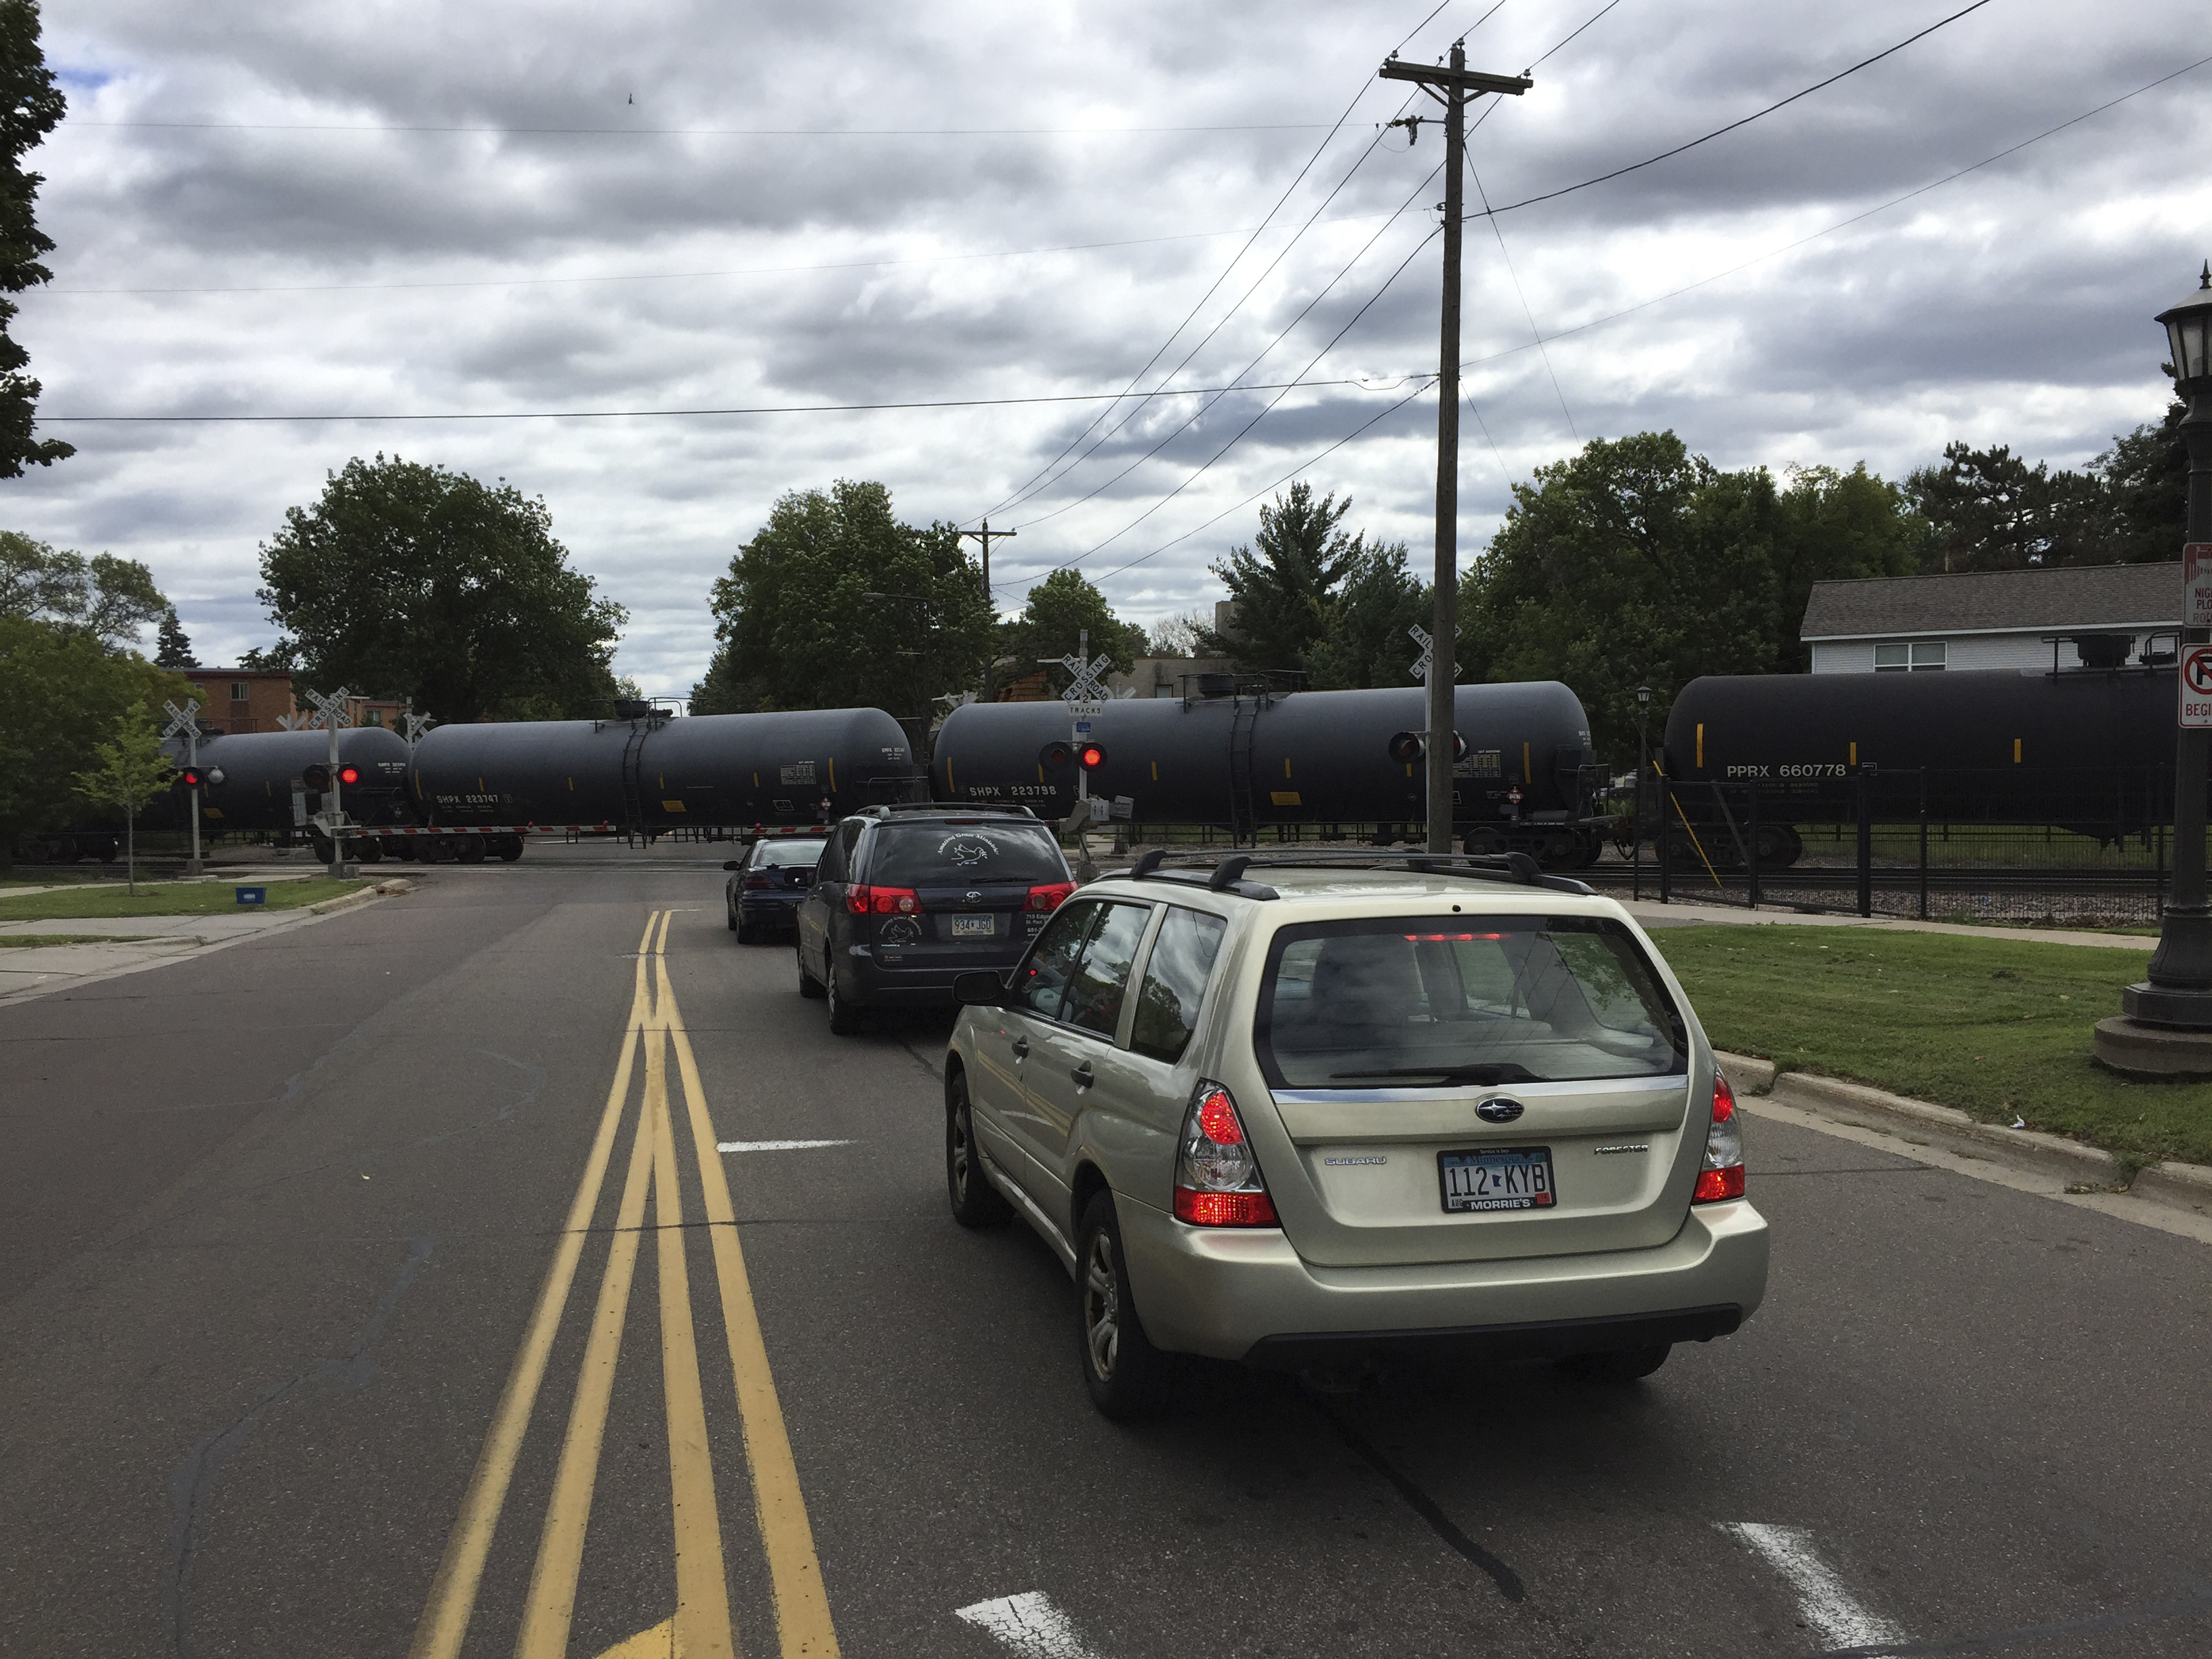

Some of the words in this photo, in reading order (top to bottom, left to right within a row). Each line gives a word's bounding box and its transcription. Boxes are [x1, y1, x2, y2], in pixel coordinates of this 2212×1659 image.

[2195, 588, 2212, 598] NIG
[1410, 626, 1431, 649] RAIL
[1064, 655, 1109, 701] CROSSING
[1082, 694, 1088, 703] 2
[310, 689, 348, 727] CROSSING
[164, 702, 199, 737] CROSSING
[1727, 764, 1770, 777] PPRX
[1779, 764, 1846, 777] 660778
[969, 786, 1001, 796] SHPX
[1010, 785, 1057, 796] 223798
[436, 795, 462, 803] SHPX
[465, 794, 499, 803] 223747
[955, 920, 970, 930] 934
[1594, 1144, 1649, 1155] FORESTER
[1324, 1156, 1387, 1166] SUBARU
[1470, 1155, 1519, 1164] Minnesota
[1450, 1166, 1490, 1197] 112
[1504, 1164, 1546, 1194] KYB
[1452, 1199, 1463, 1207] AUG
[1471, 1198, 1531, 1210] MORRIE'S
